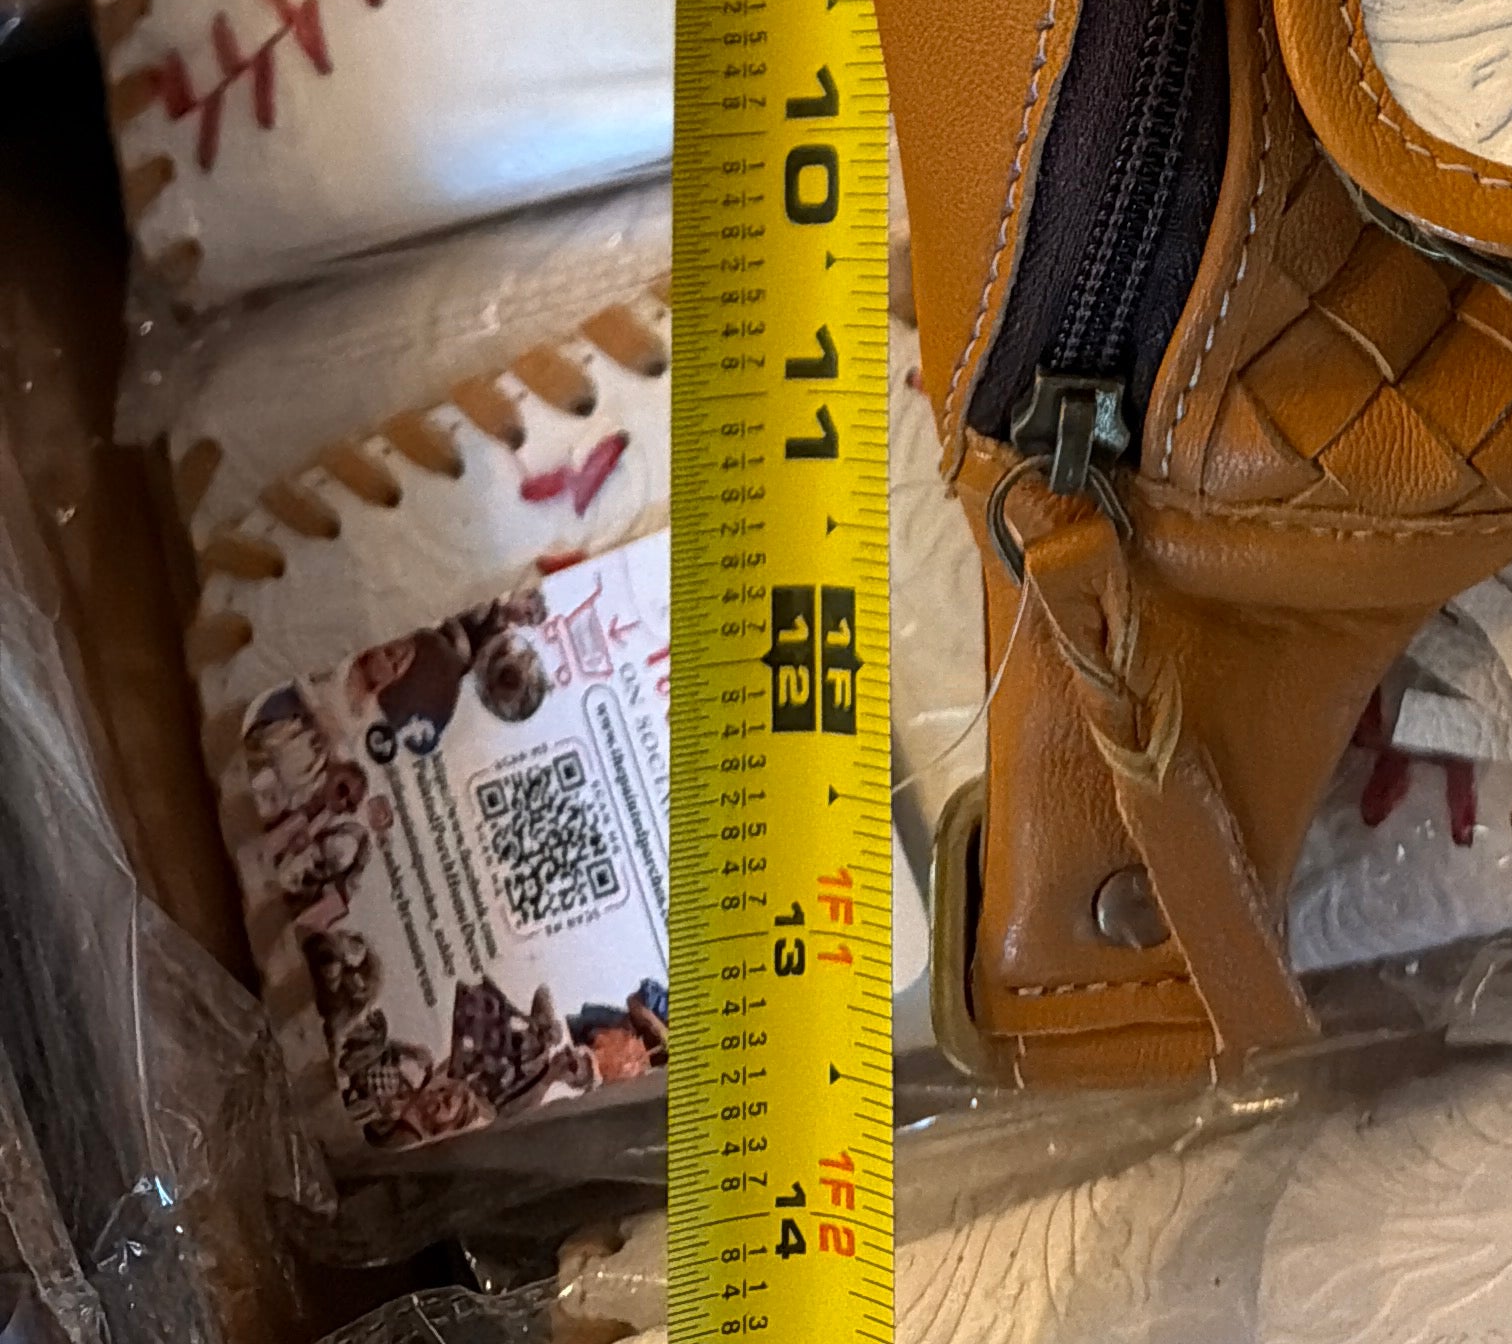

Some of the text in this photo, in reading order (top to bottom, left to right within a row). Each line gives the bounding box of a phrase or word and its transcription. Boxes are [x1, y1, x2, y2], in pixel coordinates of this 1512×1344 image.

[783, 64, 839, 226] 10
[783, 324, 839, 460] 11
[776, 614, 809, 711] 12
[824, 617, 851, 713] 1F
[635, 714, 669, 810] SOCIA
[773, 901, 805, 977] 13
[774, 1181, 805, 1260] 14
